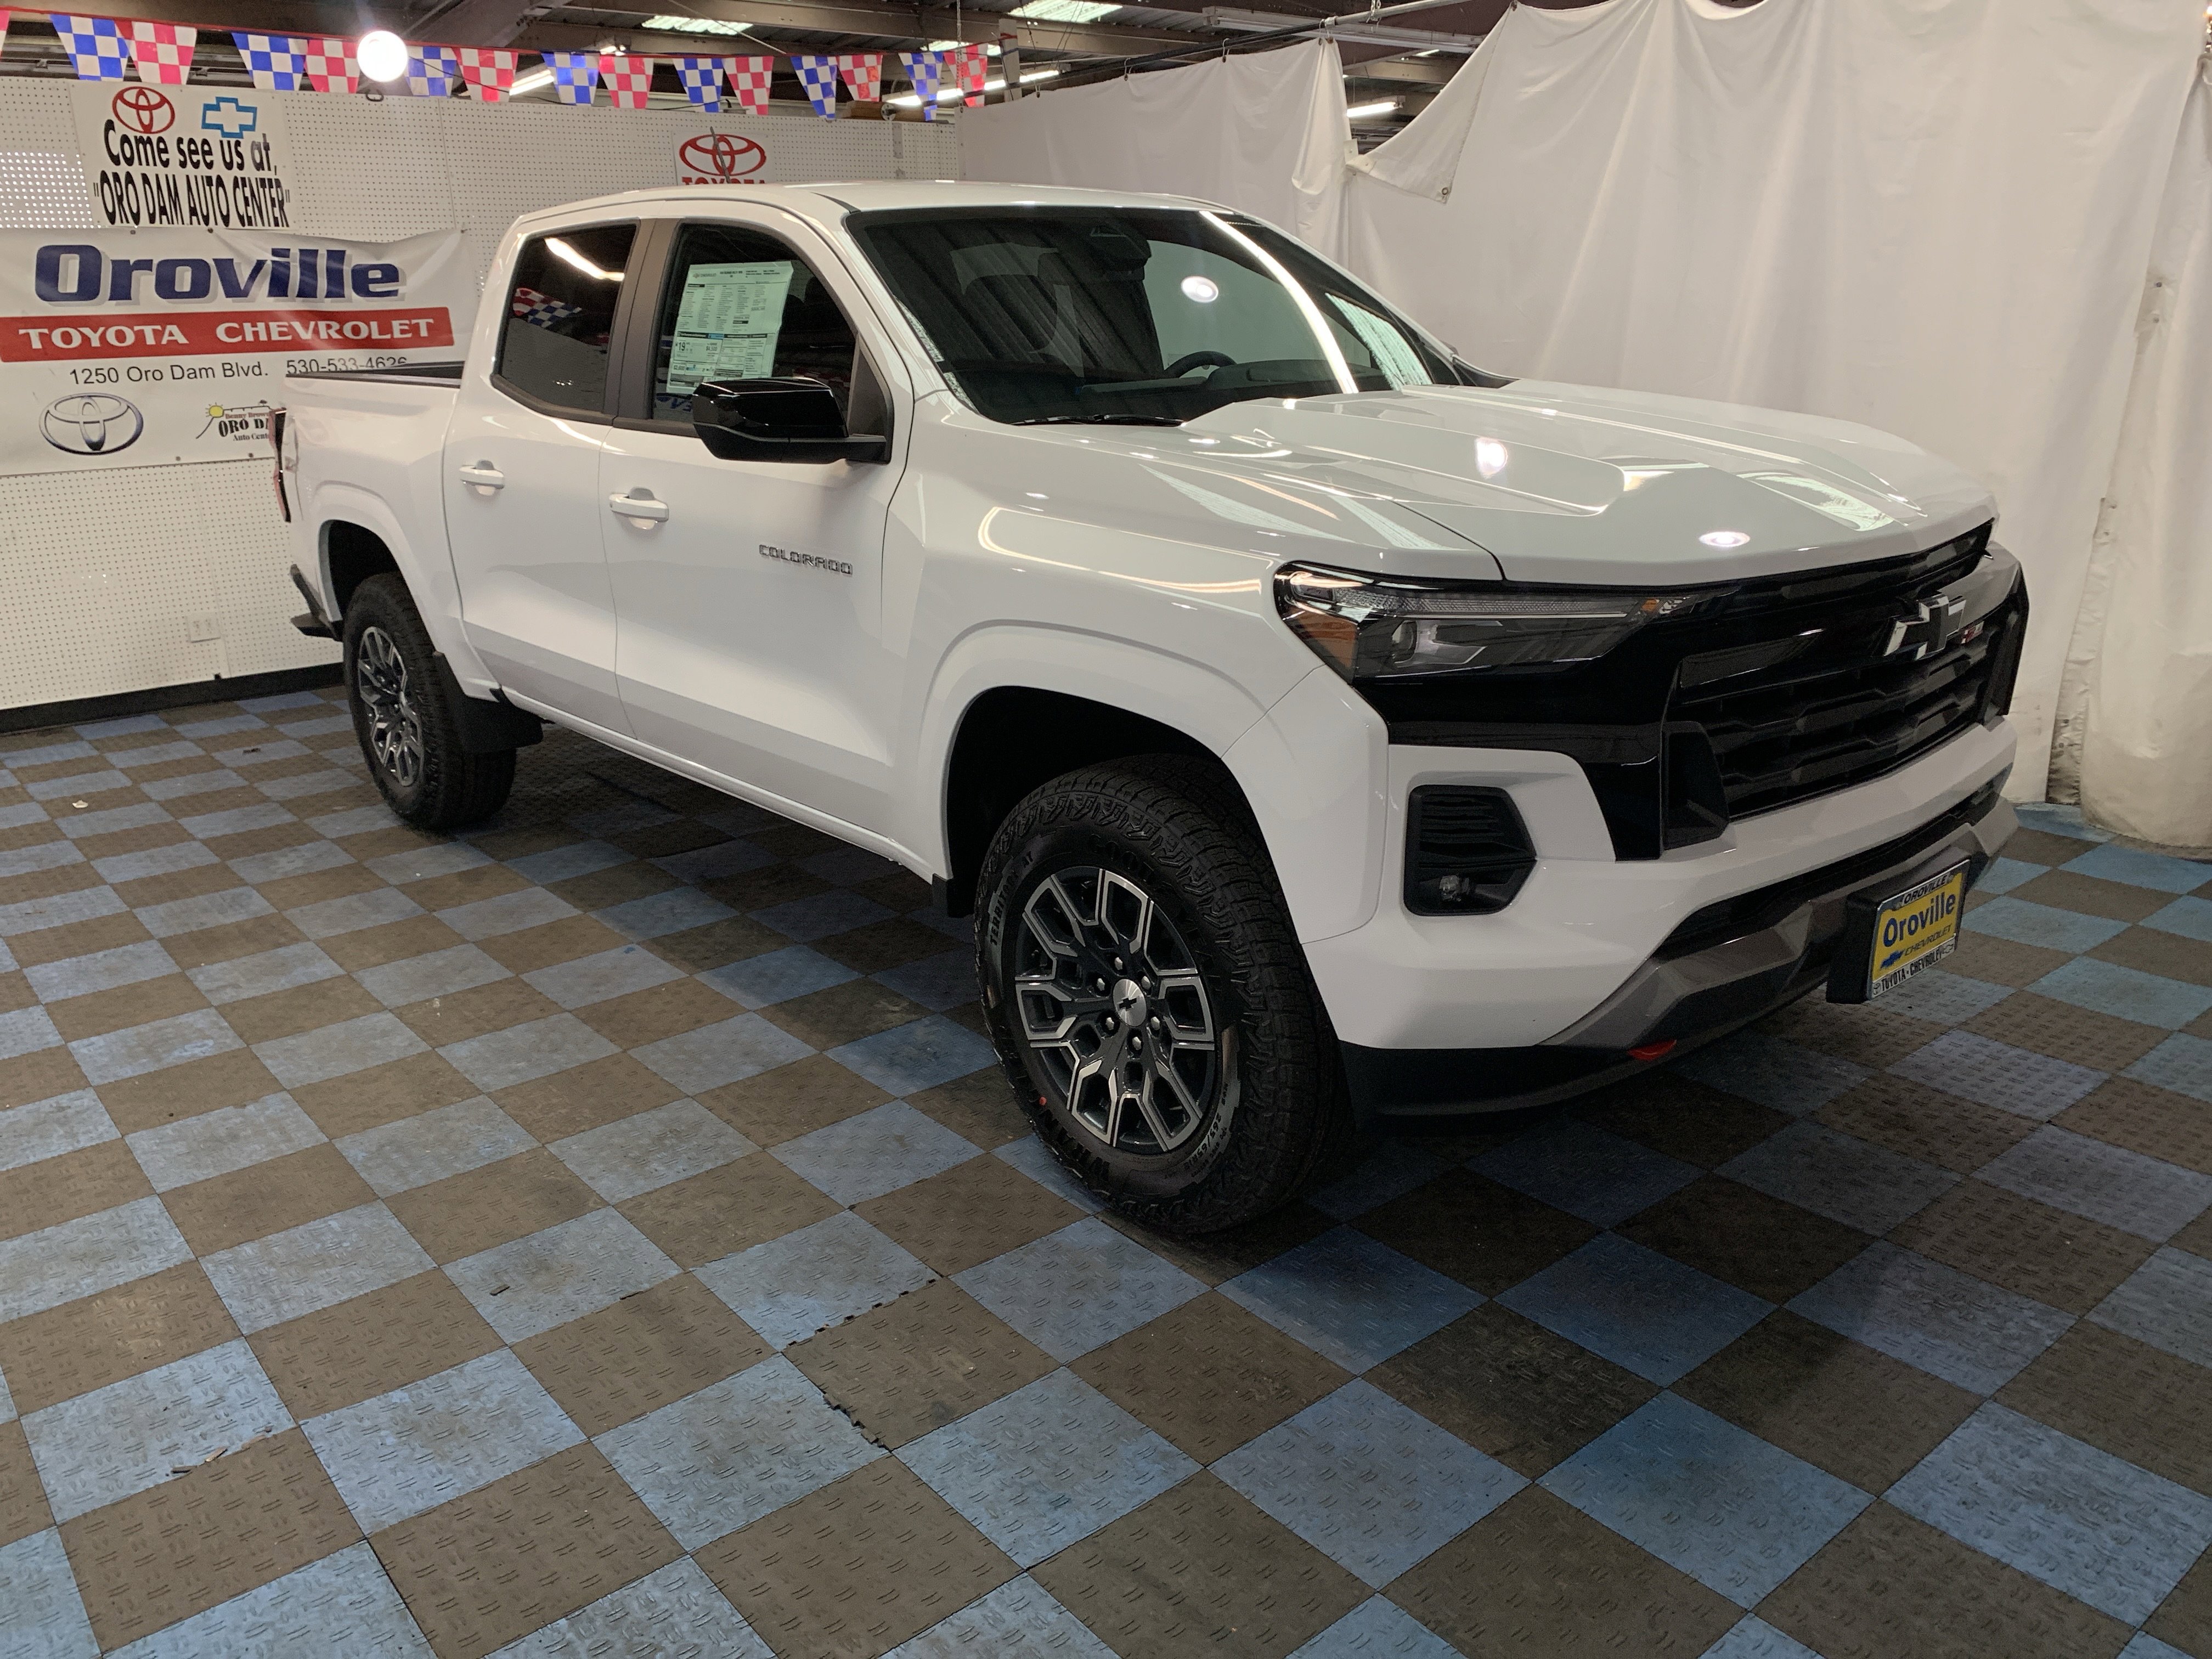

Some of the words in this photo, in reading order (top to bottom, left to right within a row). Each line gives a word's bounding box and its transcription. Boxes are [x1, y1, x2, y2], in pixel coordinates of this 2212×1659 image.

[104, 119, 170, 168] Come
[177, 137, 214, 170] see
[219, 139, 245, 171] us
[140, 172, 185, 225] DAM
[185, 174, 230, 227] AUTO
[35, 245, 402, 302] Oroville
[18, 324, 189, 350] TOYOTA
[215, 318, 435, 343] CHEVROLET
[679, 342, 685, 351] 19
[69, 366, 120, 385] 1250
[126, 366, 163, 382] Oro
[170, 363, 216, 381] Dam
[222, 362, 268, 379] Blvd.
[219, 419, 249, 437] ORO
[759, 544, 853, 575] COLORADO
[1904, 874, 1948, 904] OROVILLE
[1883, 892, 1956, 947] Oroville
[1905, 924, 1952, 956] CHEVROLET
[1881, 968, 1906, 991] TOYOTA
[1910, 946, 1942, 975] CHEVROLET
